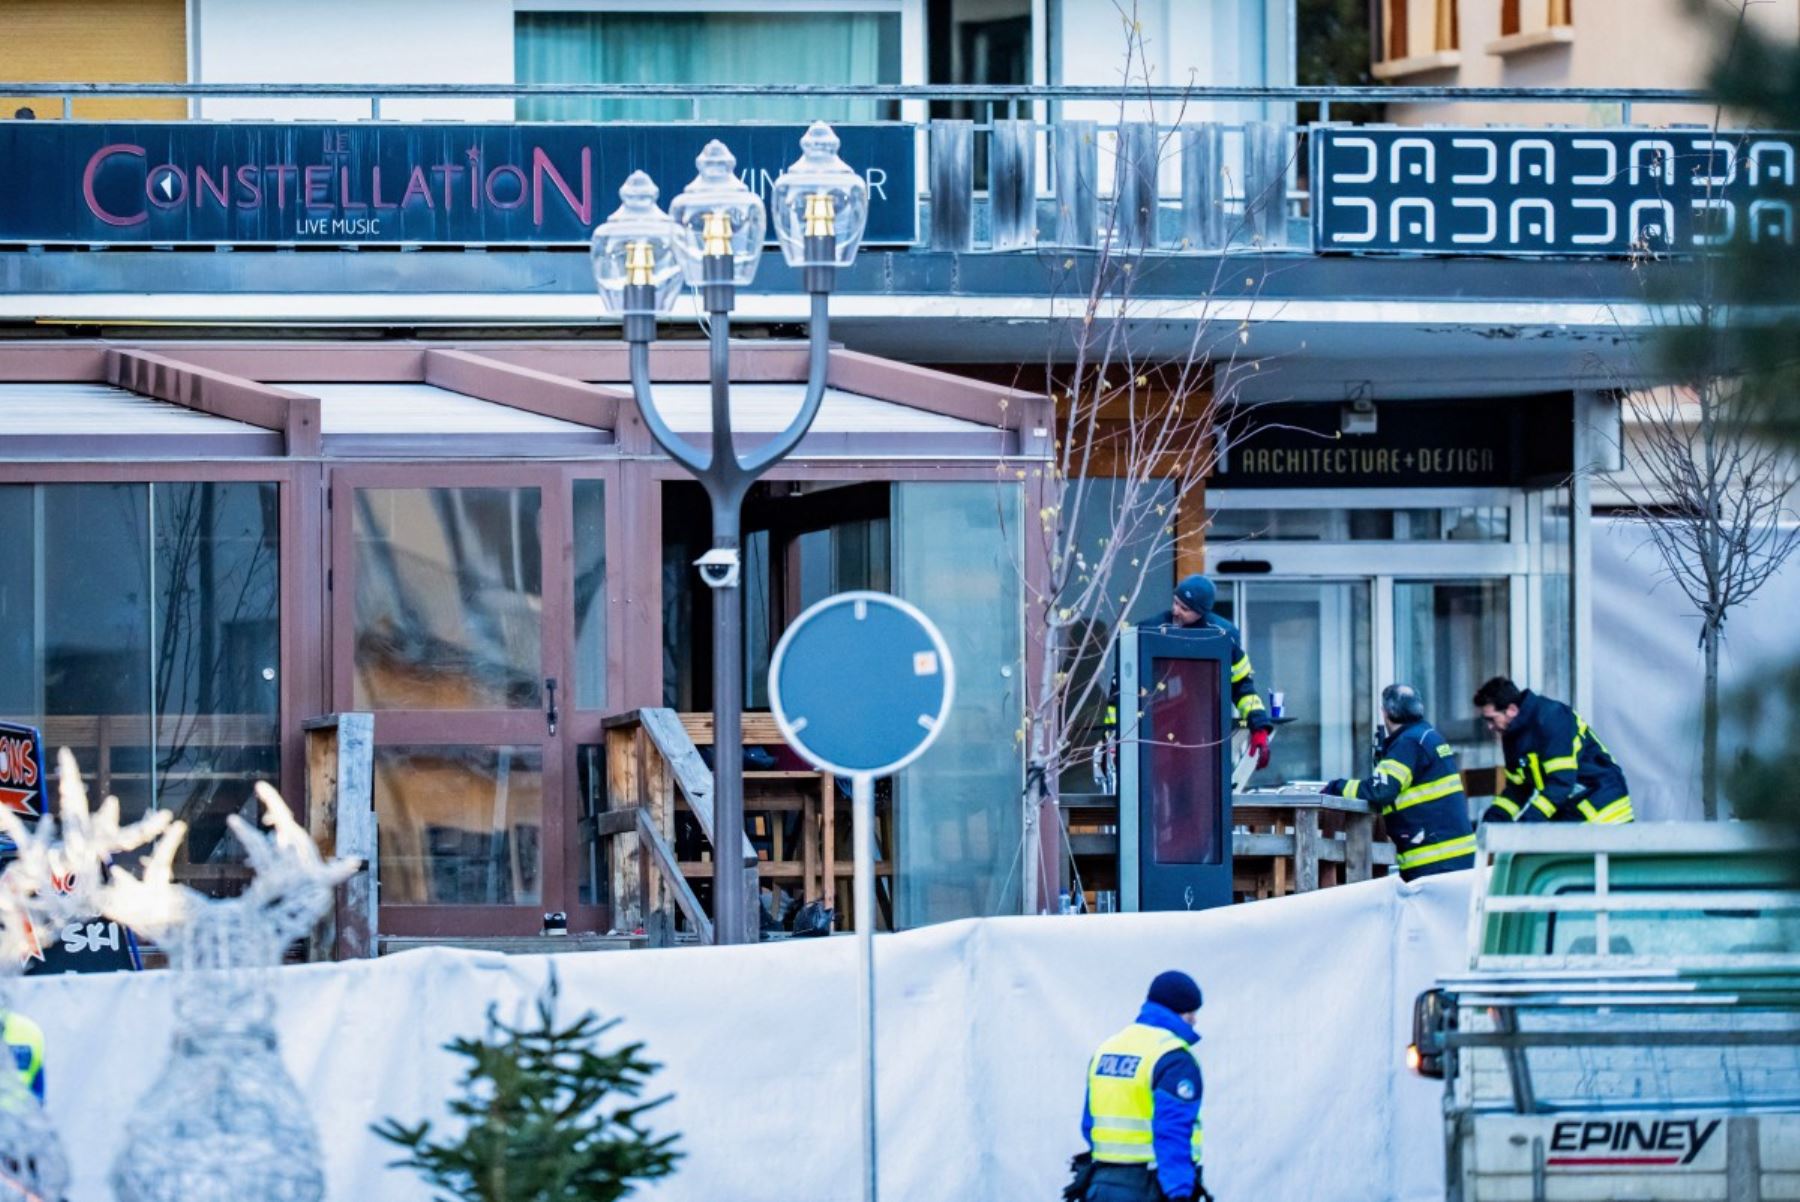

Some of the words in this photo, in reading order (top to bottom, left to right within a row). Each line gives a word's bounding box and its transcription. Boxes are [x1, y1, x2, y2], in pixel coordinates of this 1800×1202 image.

[83, 143, 592, 226] CONSTELLATION
[296, 219, 328, 235] LIVE
[332, 219, 381, 235] MUSIC
[61, 921, 119, 953] SKI
[1097, 1055, 1140, 1076] POLICE
[1550, 1118, 1722, 1165] EPINEY
